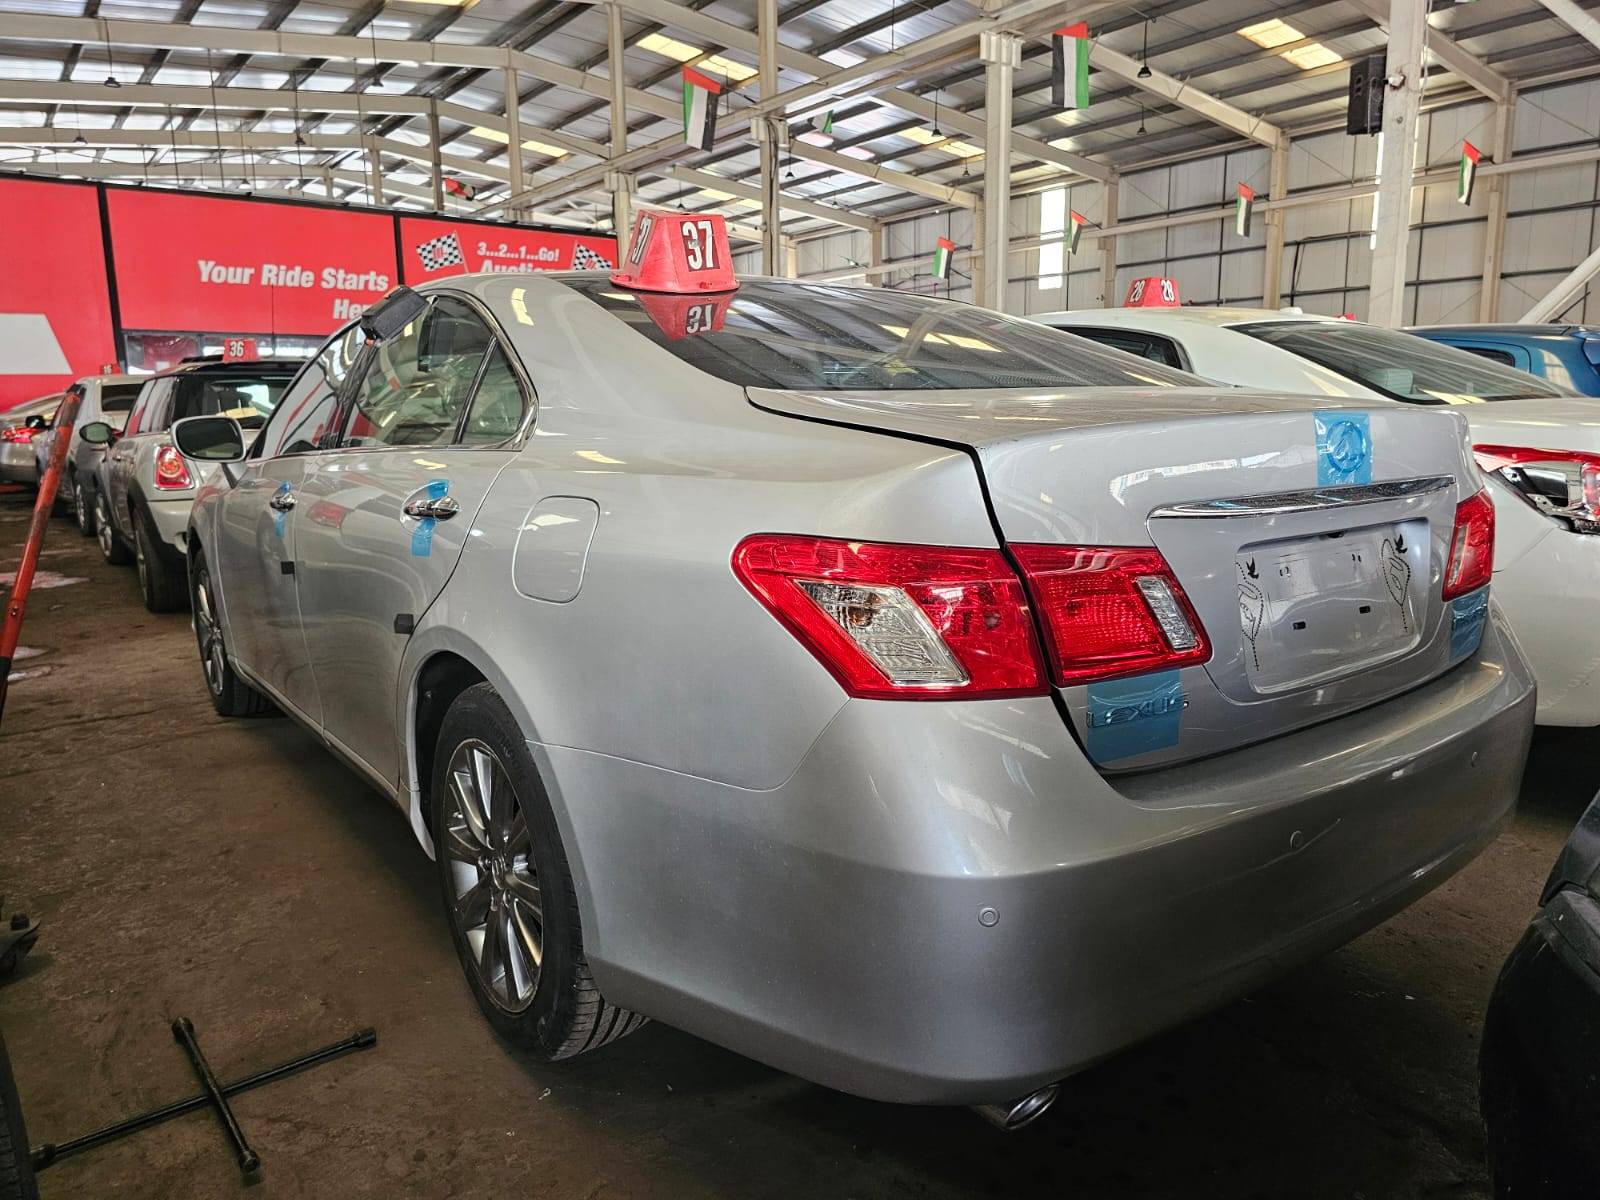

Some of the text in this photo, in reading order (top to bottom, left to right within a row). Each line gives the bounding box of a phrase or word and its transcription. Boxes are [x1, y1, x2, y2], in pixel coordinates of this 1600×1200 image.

[632, 216, 652, 264] 37
[682, 220, 714, 269] 37
[198, 260, 389, 292] Your Ride Starts
[1130, 280, 1145, 302] 28
[1161, 280, 1175, 301] 28
[230, 340, 244, 357] 36
